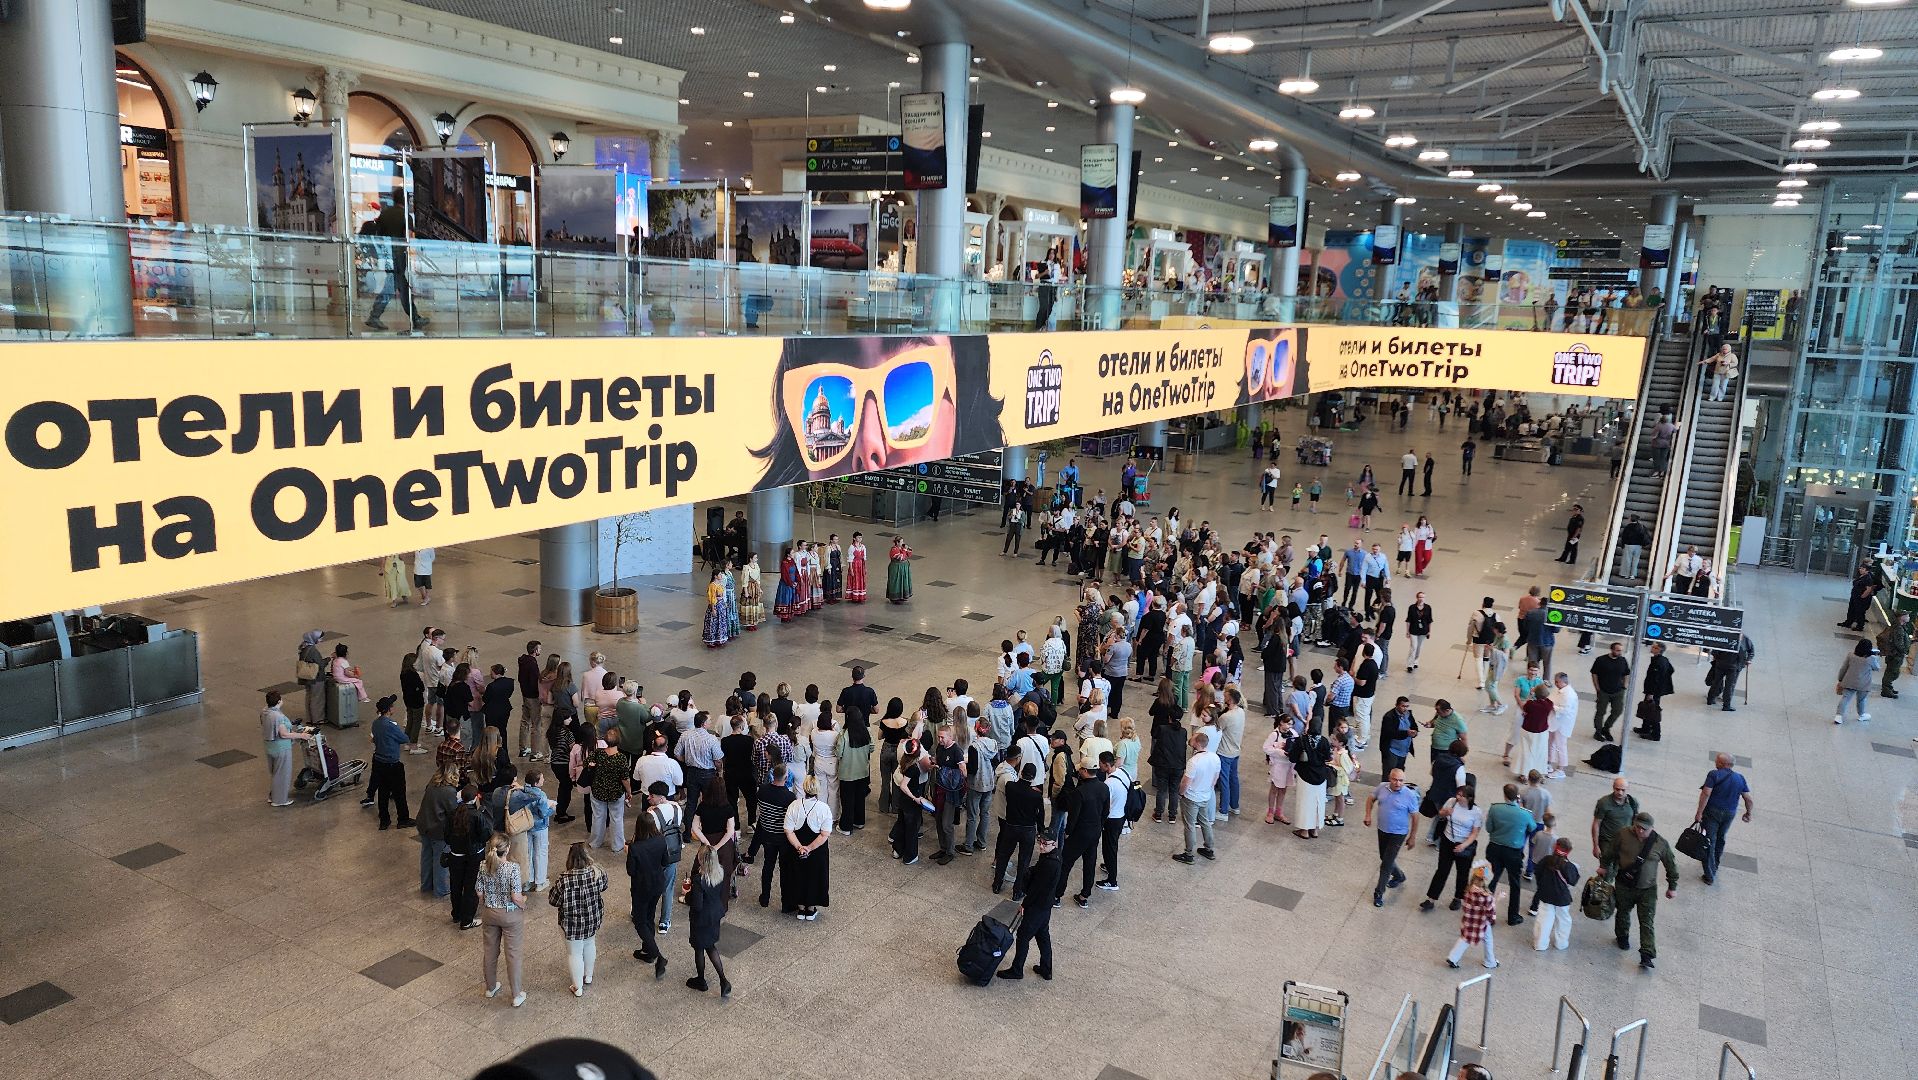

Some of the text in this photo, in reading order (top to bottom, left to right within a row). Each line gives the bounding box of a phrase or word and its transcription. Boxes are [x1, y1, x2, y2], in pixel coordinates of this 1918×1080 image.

[350, 157, 384, 170] ДЕЖДА
[1371, 340, 1381, 354] и
[1388, 335, 1482, 357] билеты
[1098, 341, 1223, 379] отели и билеты
[1350, 358, 1469, 384] OneTwoTrip
[1554, 352, 1602, 366] ONE TWO
[1028, 367, 1062, 389] ONE TWO
[1553, 363, 1600, 386] TRIP!
[1102, 372, 1216, 417] на OneTwoTrip
[4, 362, 715, 470] отели и билеты
[1026, 389, 1060, 425] TRIP!
[66, 423, 698, 573] на OneTwoTrip
[1687, 608, 1717, 618] АПТЕКА
